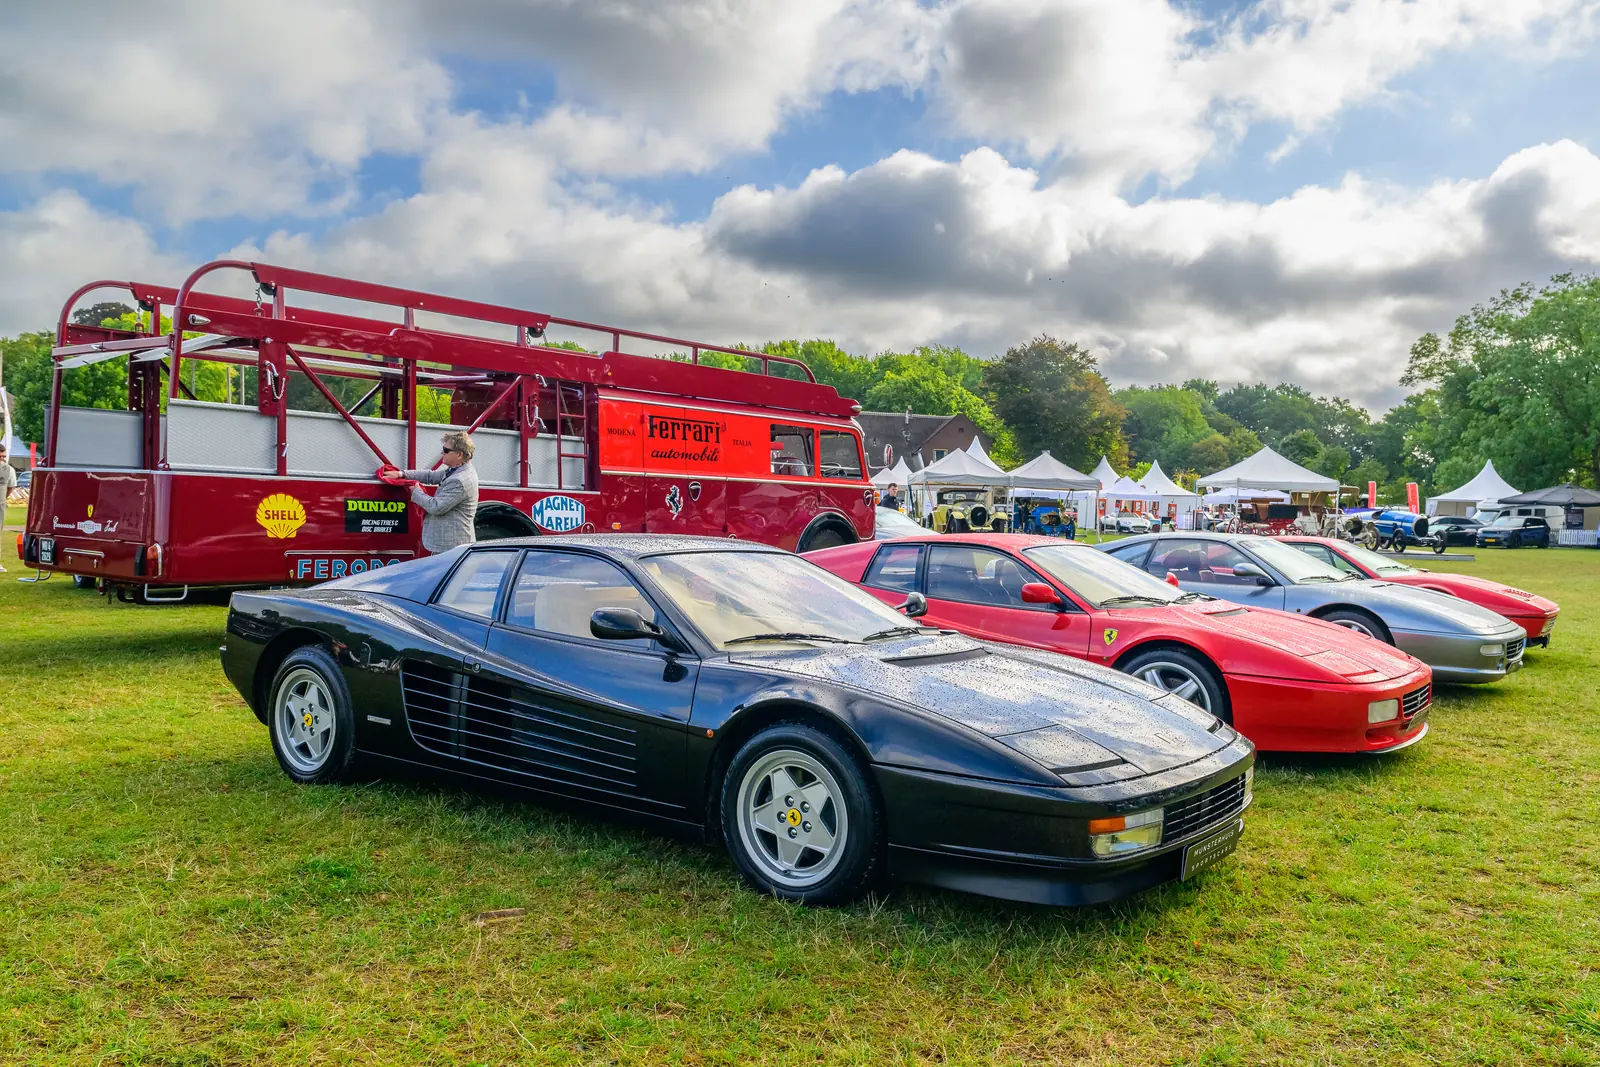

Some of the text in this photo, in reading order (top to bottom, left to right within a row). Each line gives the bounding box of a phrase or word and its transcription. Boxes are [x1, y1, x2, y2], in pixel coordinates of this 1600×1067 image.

[607, 427, 636, 437] MODENA
[648, 415, 721, 443] Ferrari
[732, 439, 752, 447] ITALIA
[651, 446, 720, 462] automobili
[347, 500, 406, 513] DUNLOP
[533, 496, 584, 516] MAGNETI
[264, 510, 299, 520] SHELL
[1191, 844, 1232, 872] SPORTSCARS
